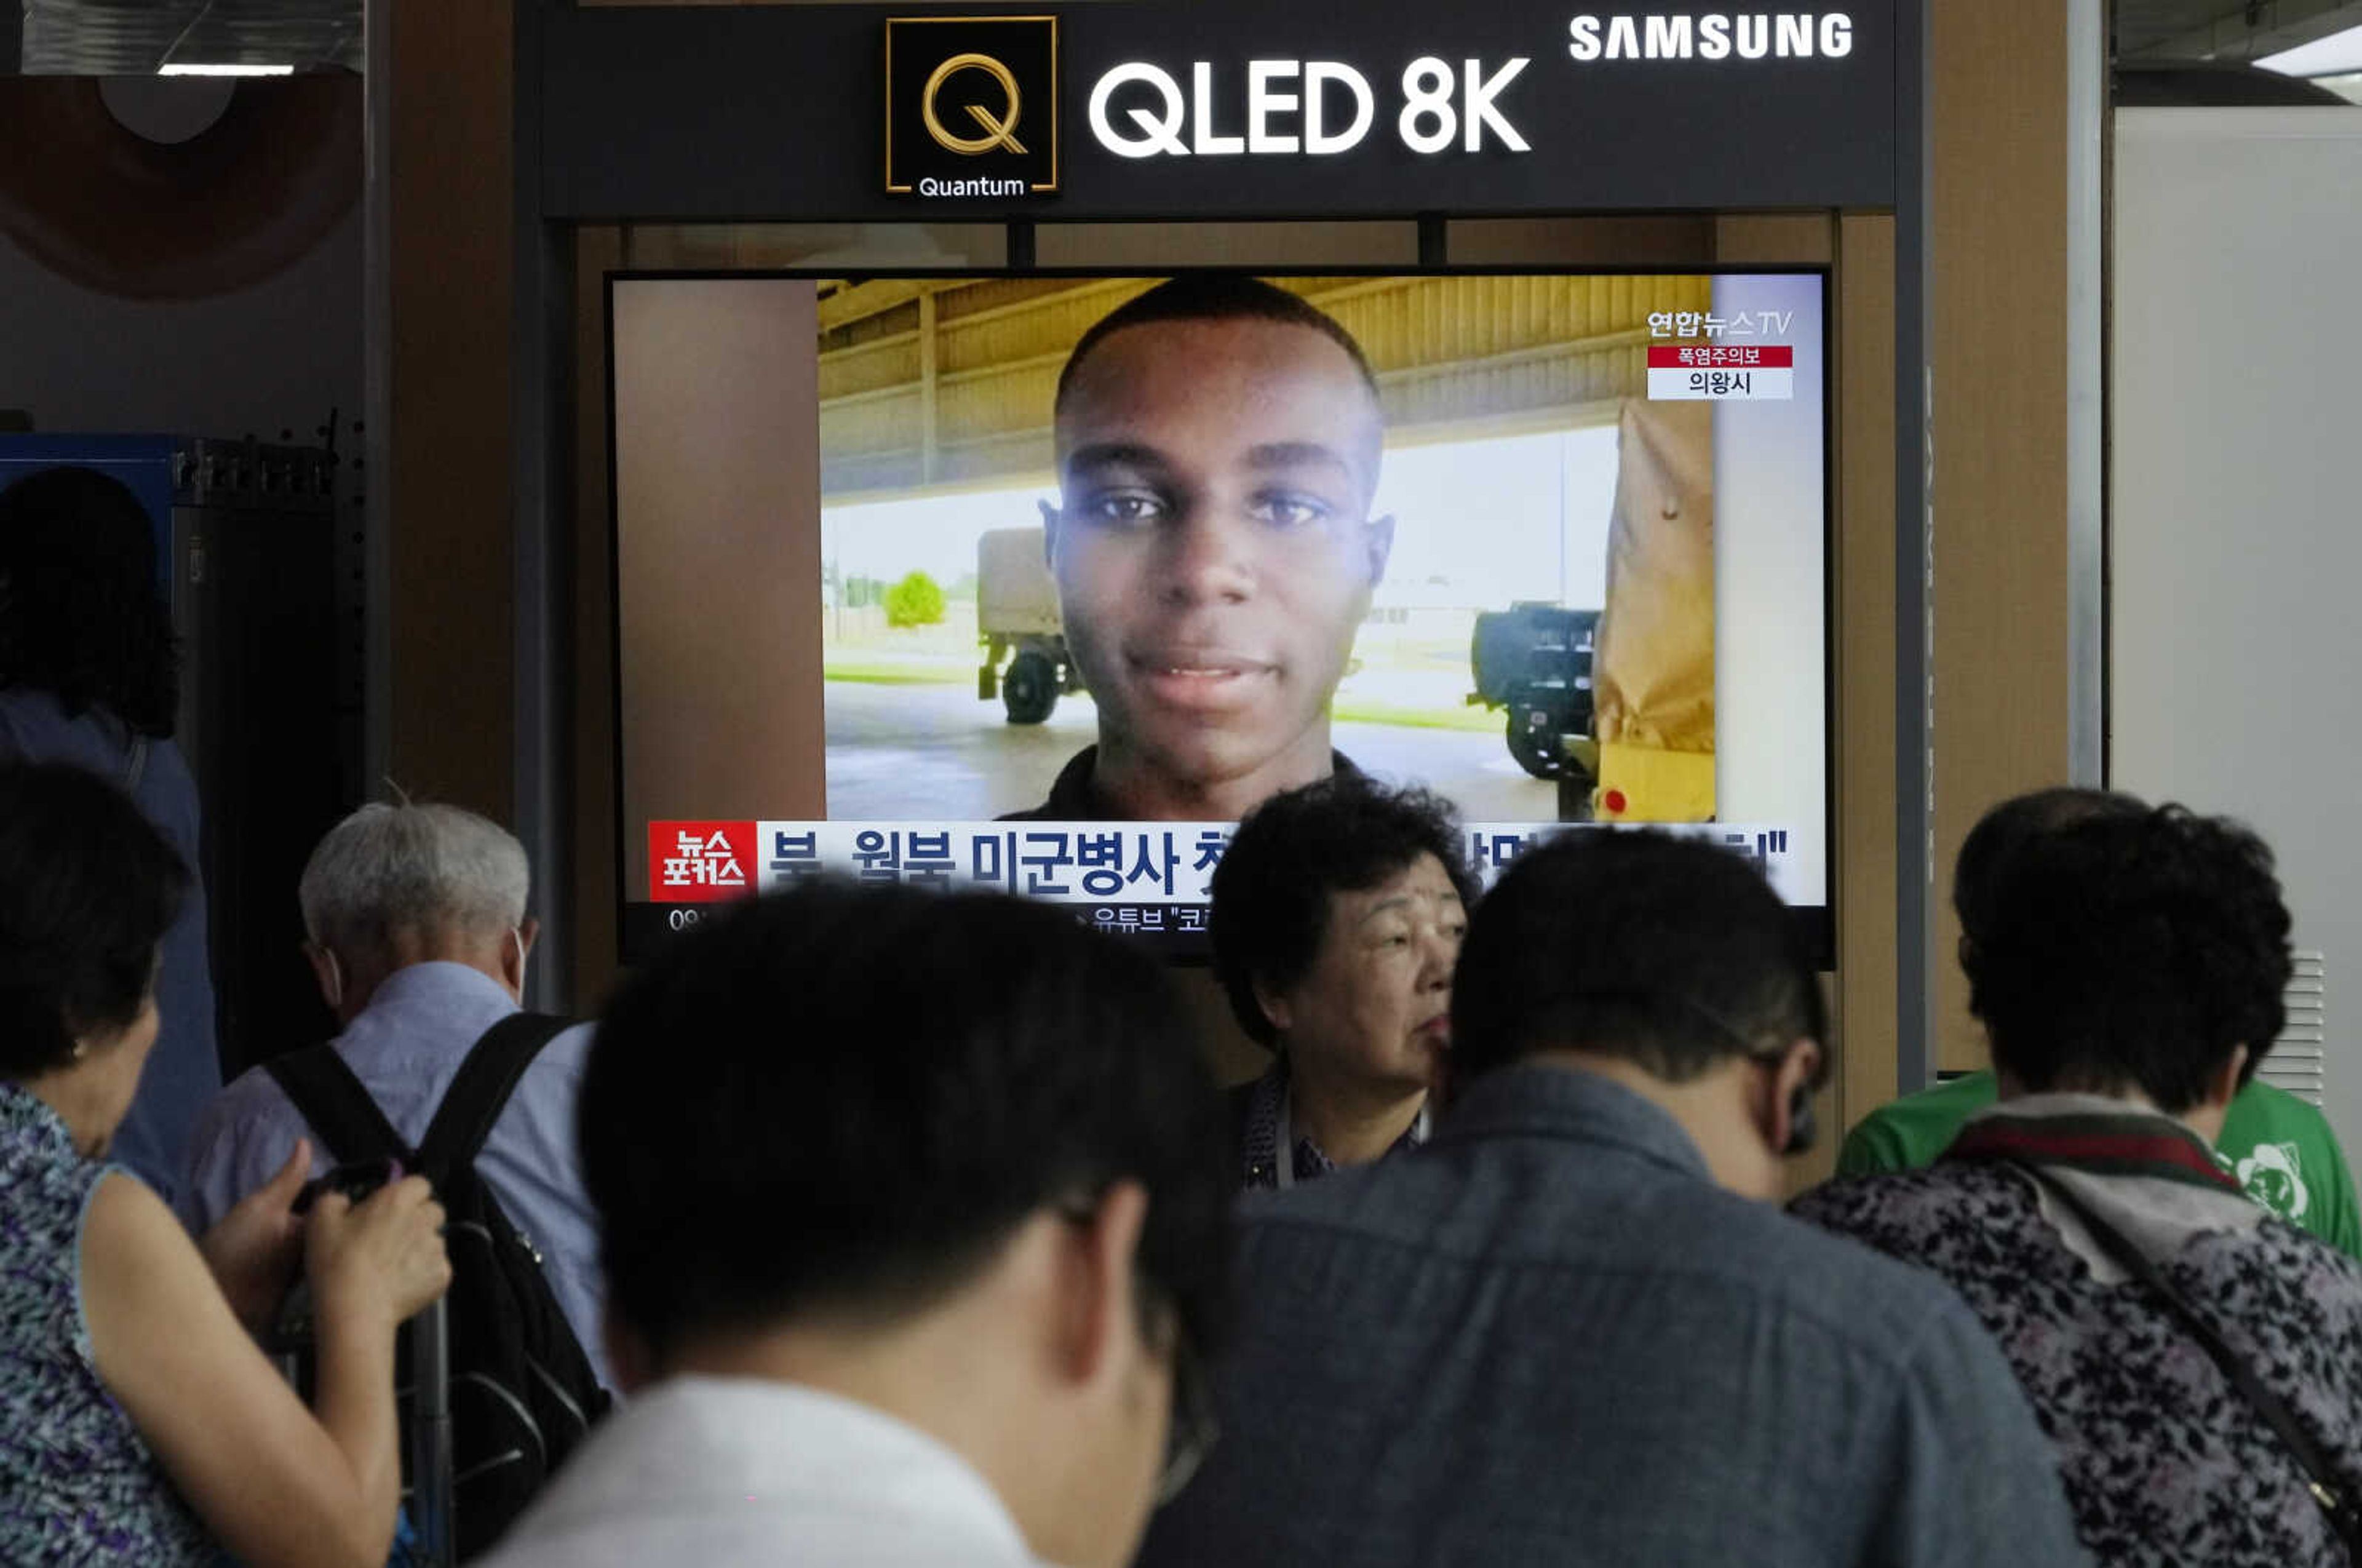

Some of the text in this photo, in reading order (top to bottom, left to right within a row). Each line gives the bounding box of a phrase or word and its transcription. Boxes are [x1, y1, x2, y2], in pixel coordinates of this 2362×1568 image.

[1569, 13, 1852, 60] SAMSUNG
[1088, 57, 1532, 158] QLED 8K
[920, 177, 1025, 196] Quantum
[1679, 347, 1760, 365] 폭염주의보
[1690, 372, 1751, 394] 의왕시
[677, 830, 733, 857] 뉴스
[663, 858, 745, 885] 포커스
[972, 832, 1180, 897] 미군병사
[1093, 907, 1165, 934] 유튜브
